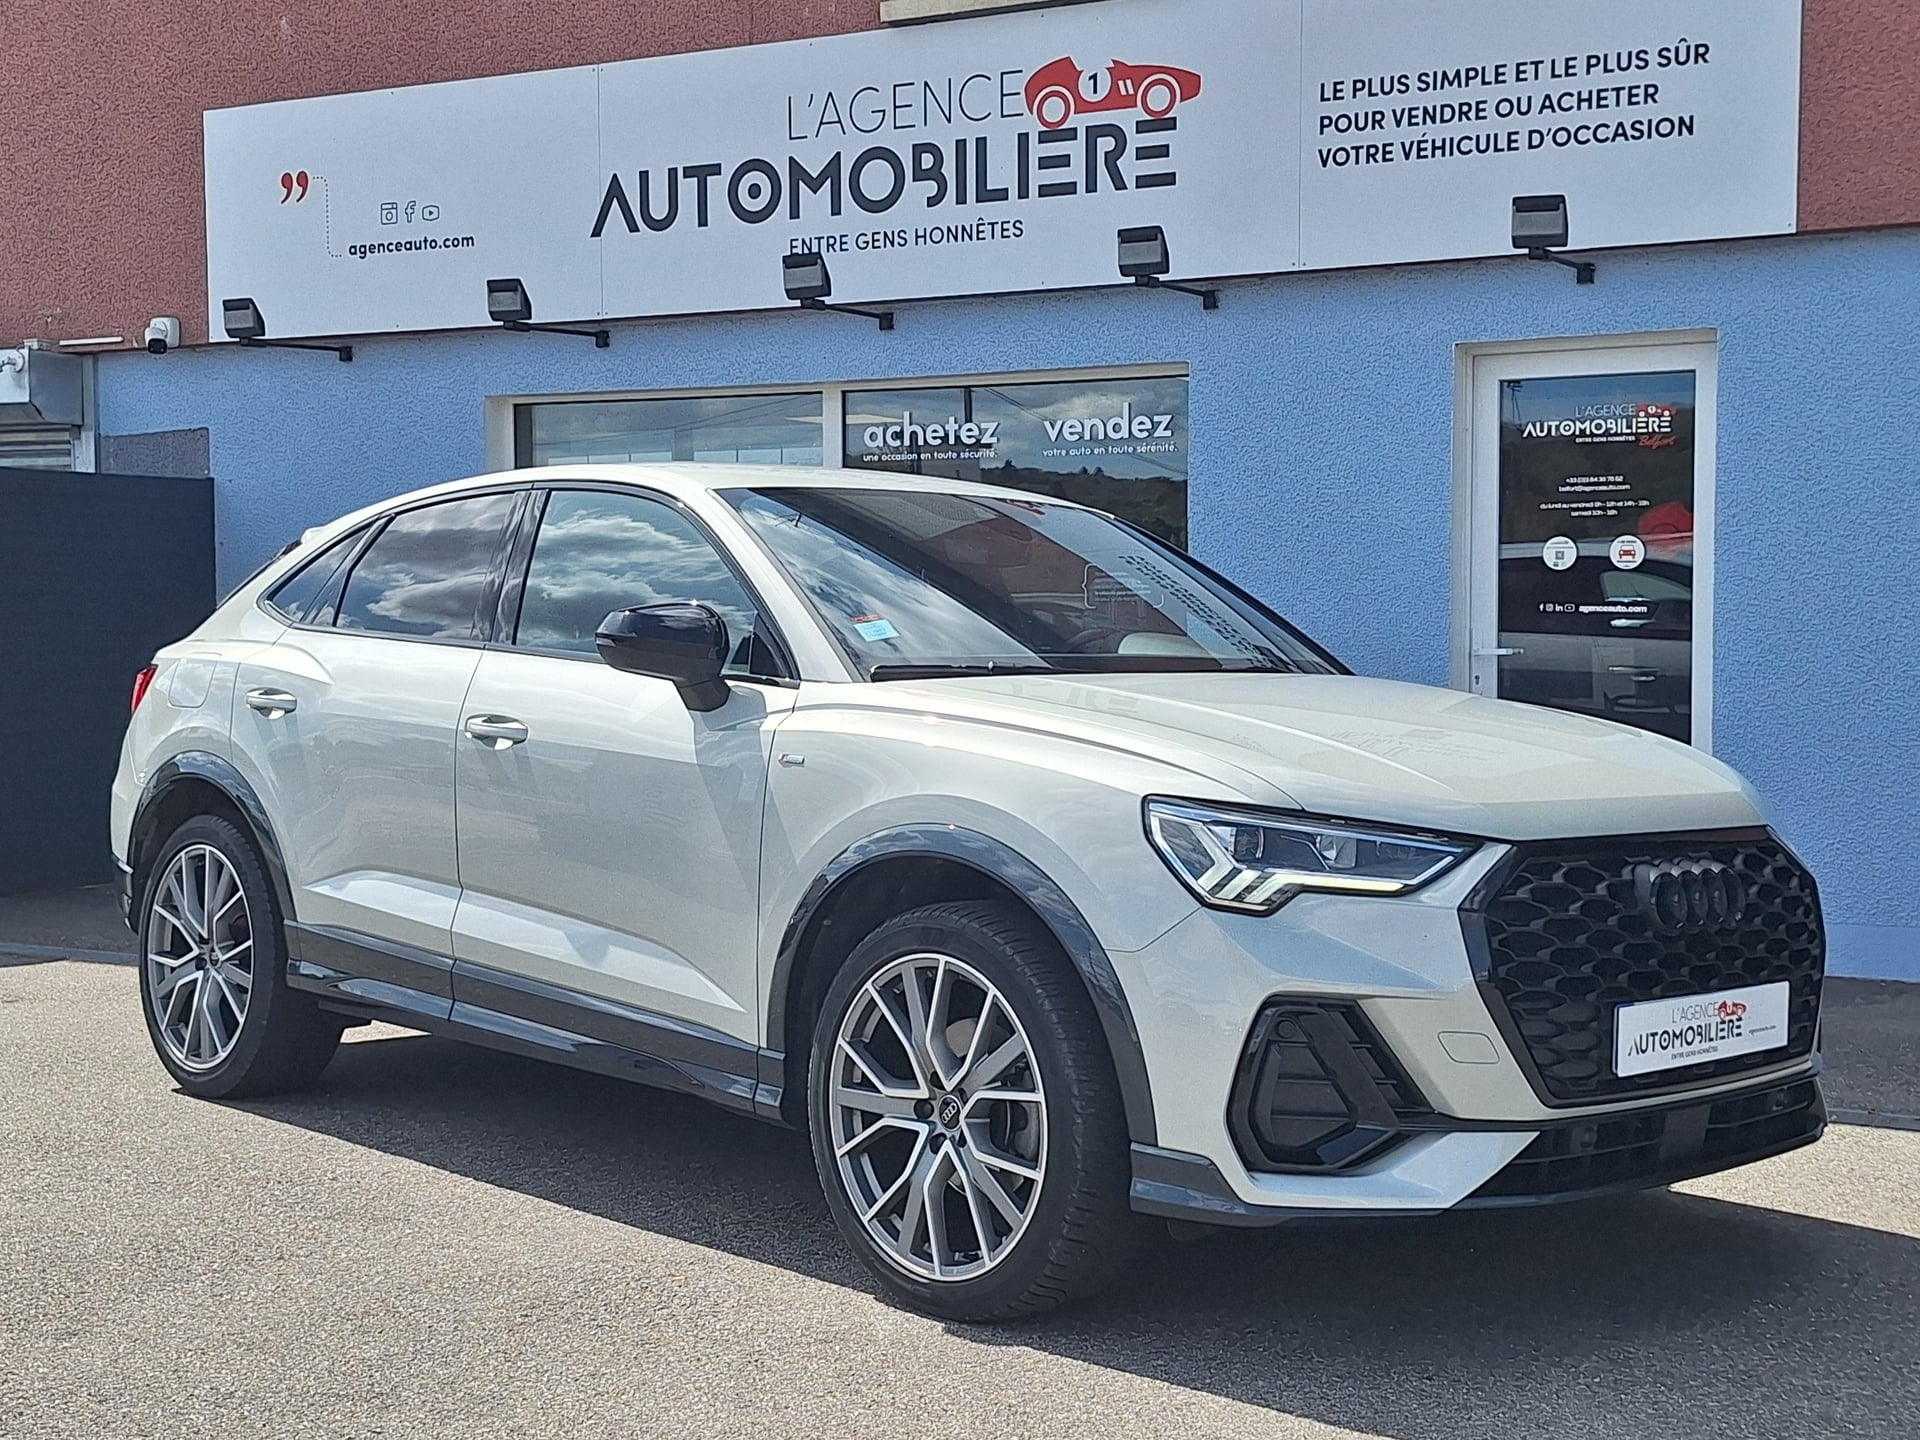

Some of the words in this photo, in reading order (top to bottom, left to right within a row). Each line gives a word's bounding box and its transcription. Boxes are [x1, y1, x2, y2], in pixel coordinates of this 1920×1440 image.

[1319, 81, 1345, 102] LE
[1352, 74, 1411, 99] PLUS
[1416, 64, 1507, 92] SIMPLE
[1514, 59, 1544, 82] ET
[1550, 56, 1578, 79] LE
[1585, 49, 1650, 76] PLUS
[1656, 37, 1710, 67] SÛR
[788, 70, 1024, 141] L'AGENCE
[1319, 110, 1386, 135] POUR
[1392, 100, 1488, 128] VENDRE
[1494, 95, 1533, 118] OU
[1538, 83, 1659, 115] ACHETER
[1318, 142, 1395, 168] VOTRE
[1400, 132, 1520, 161] VÉHICULE
[1527, 115, 1695, 151] D'OCCASION
[348, 234, 475, 259] agenceauto.com
[789, 234, 849, 254] ENTRE
[855, 229, 908, 251] GENS
[914, 217, 1024, 246] HONNÊTES
[1043, 401, 1173, 442] vendez
[1575, 403, 1636, 418] L'AGENCE
[863, 411, 999, 448] achetez
[863, 454, 879, 462] une
[881, 451, 918, 461] occasion
[934, 450, 957, 460] toute
[960, 447, 998, 459] sécurité.
[1043, 448, 1067, 457] votre
[1069, 446, 1092, 456] auto
[1108, 445, 1134, 454] toute
